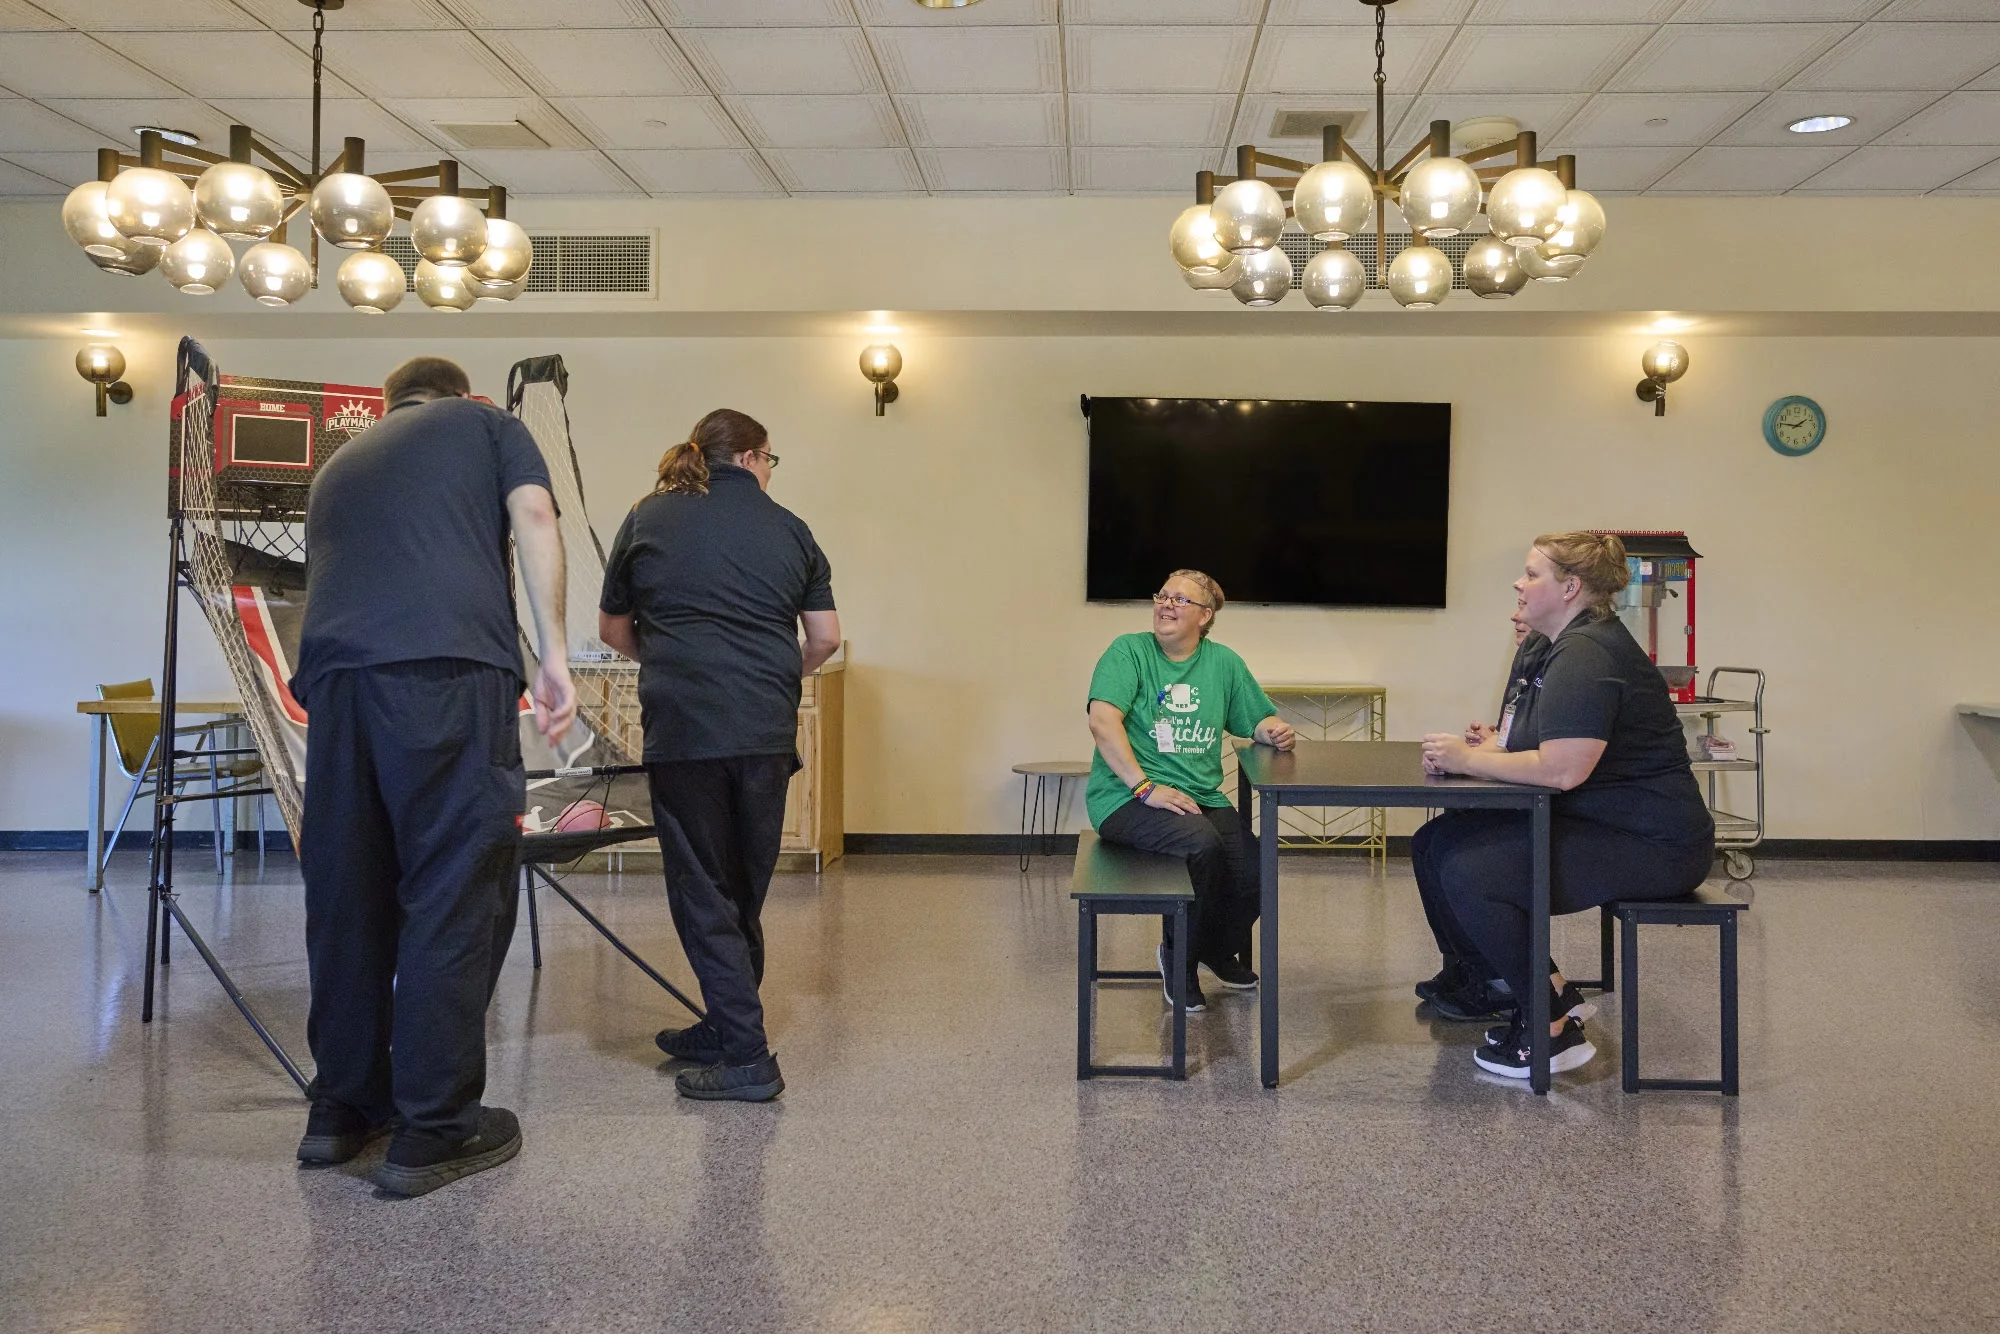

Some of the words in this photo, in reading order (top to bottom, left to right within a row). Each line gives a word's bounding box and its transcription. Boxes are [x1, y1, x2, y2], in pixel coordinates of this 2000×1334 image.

[260, 403, 285, 412] HOME
[328, 417, 377, 430] PLAYMAKE
[1172, 716, 1184, 725] I'm
[1185, 717, 1191, 726] A
